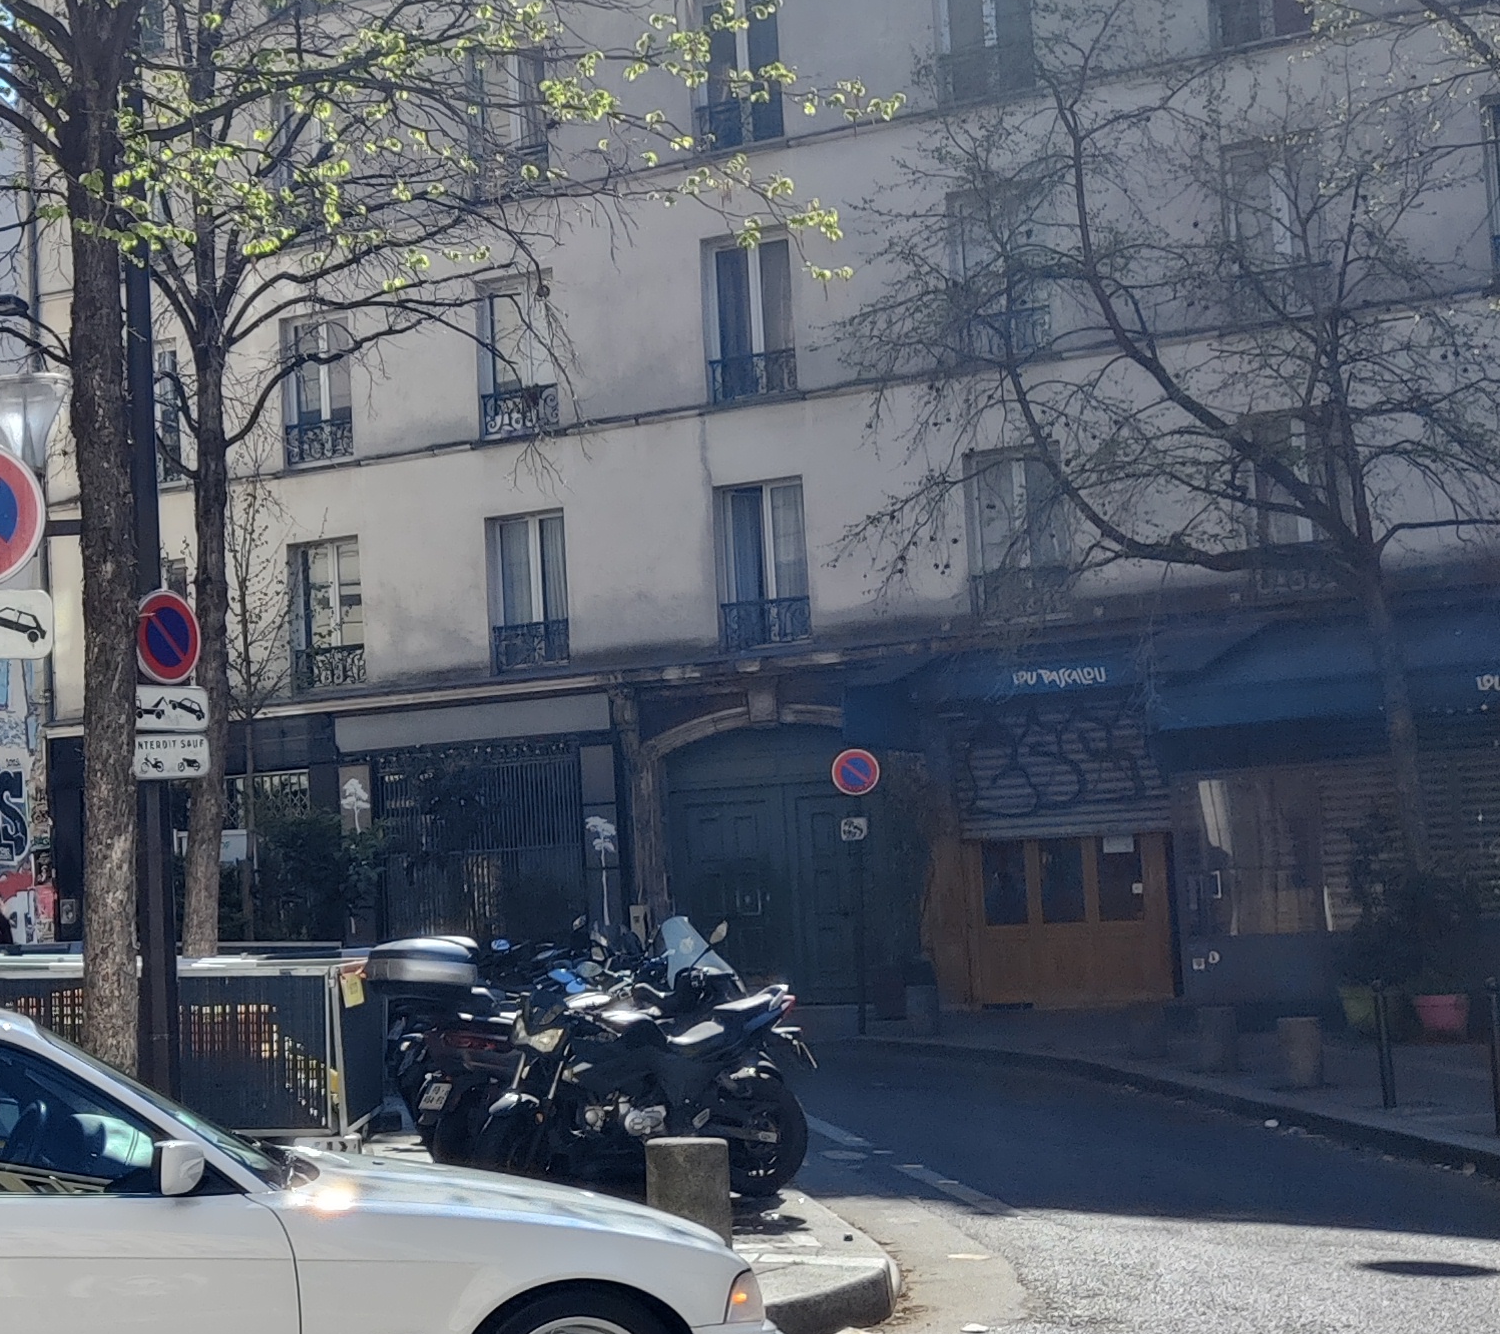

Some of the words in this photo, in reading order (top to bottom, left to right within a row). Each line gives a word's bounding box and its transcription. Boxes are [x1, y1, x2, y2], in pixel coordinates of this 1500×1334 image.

[1013, 670, 1037, 685] LOU
[1038, 666, 1107, 688] PASCALOU
[137, 739, 177, 750] NTERDIT
[180, 738, 205, 749] SAUF
